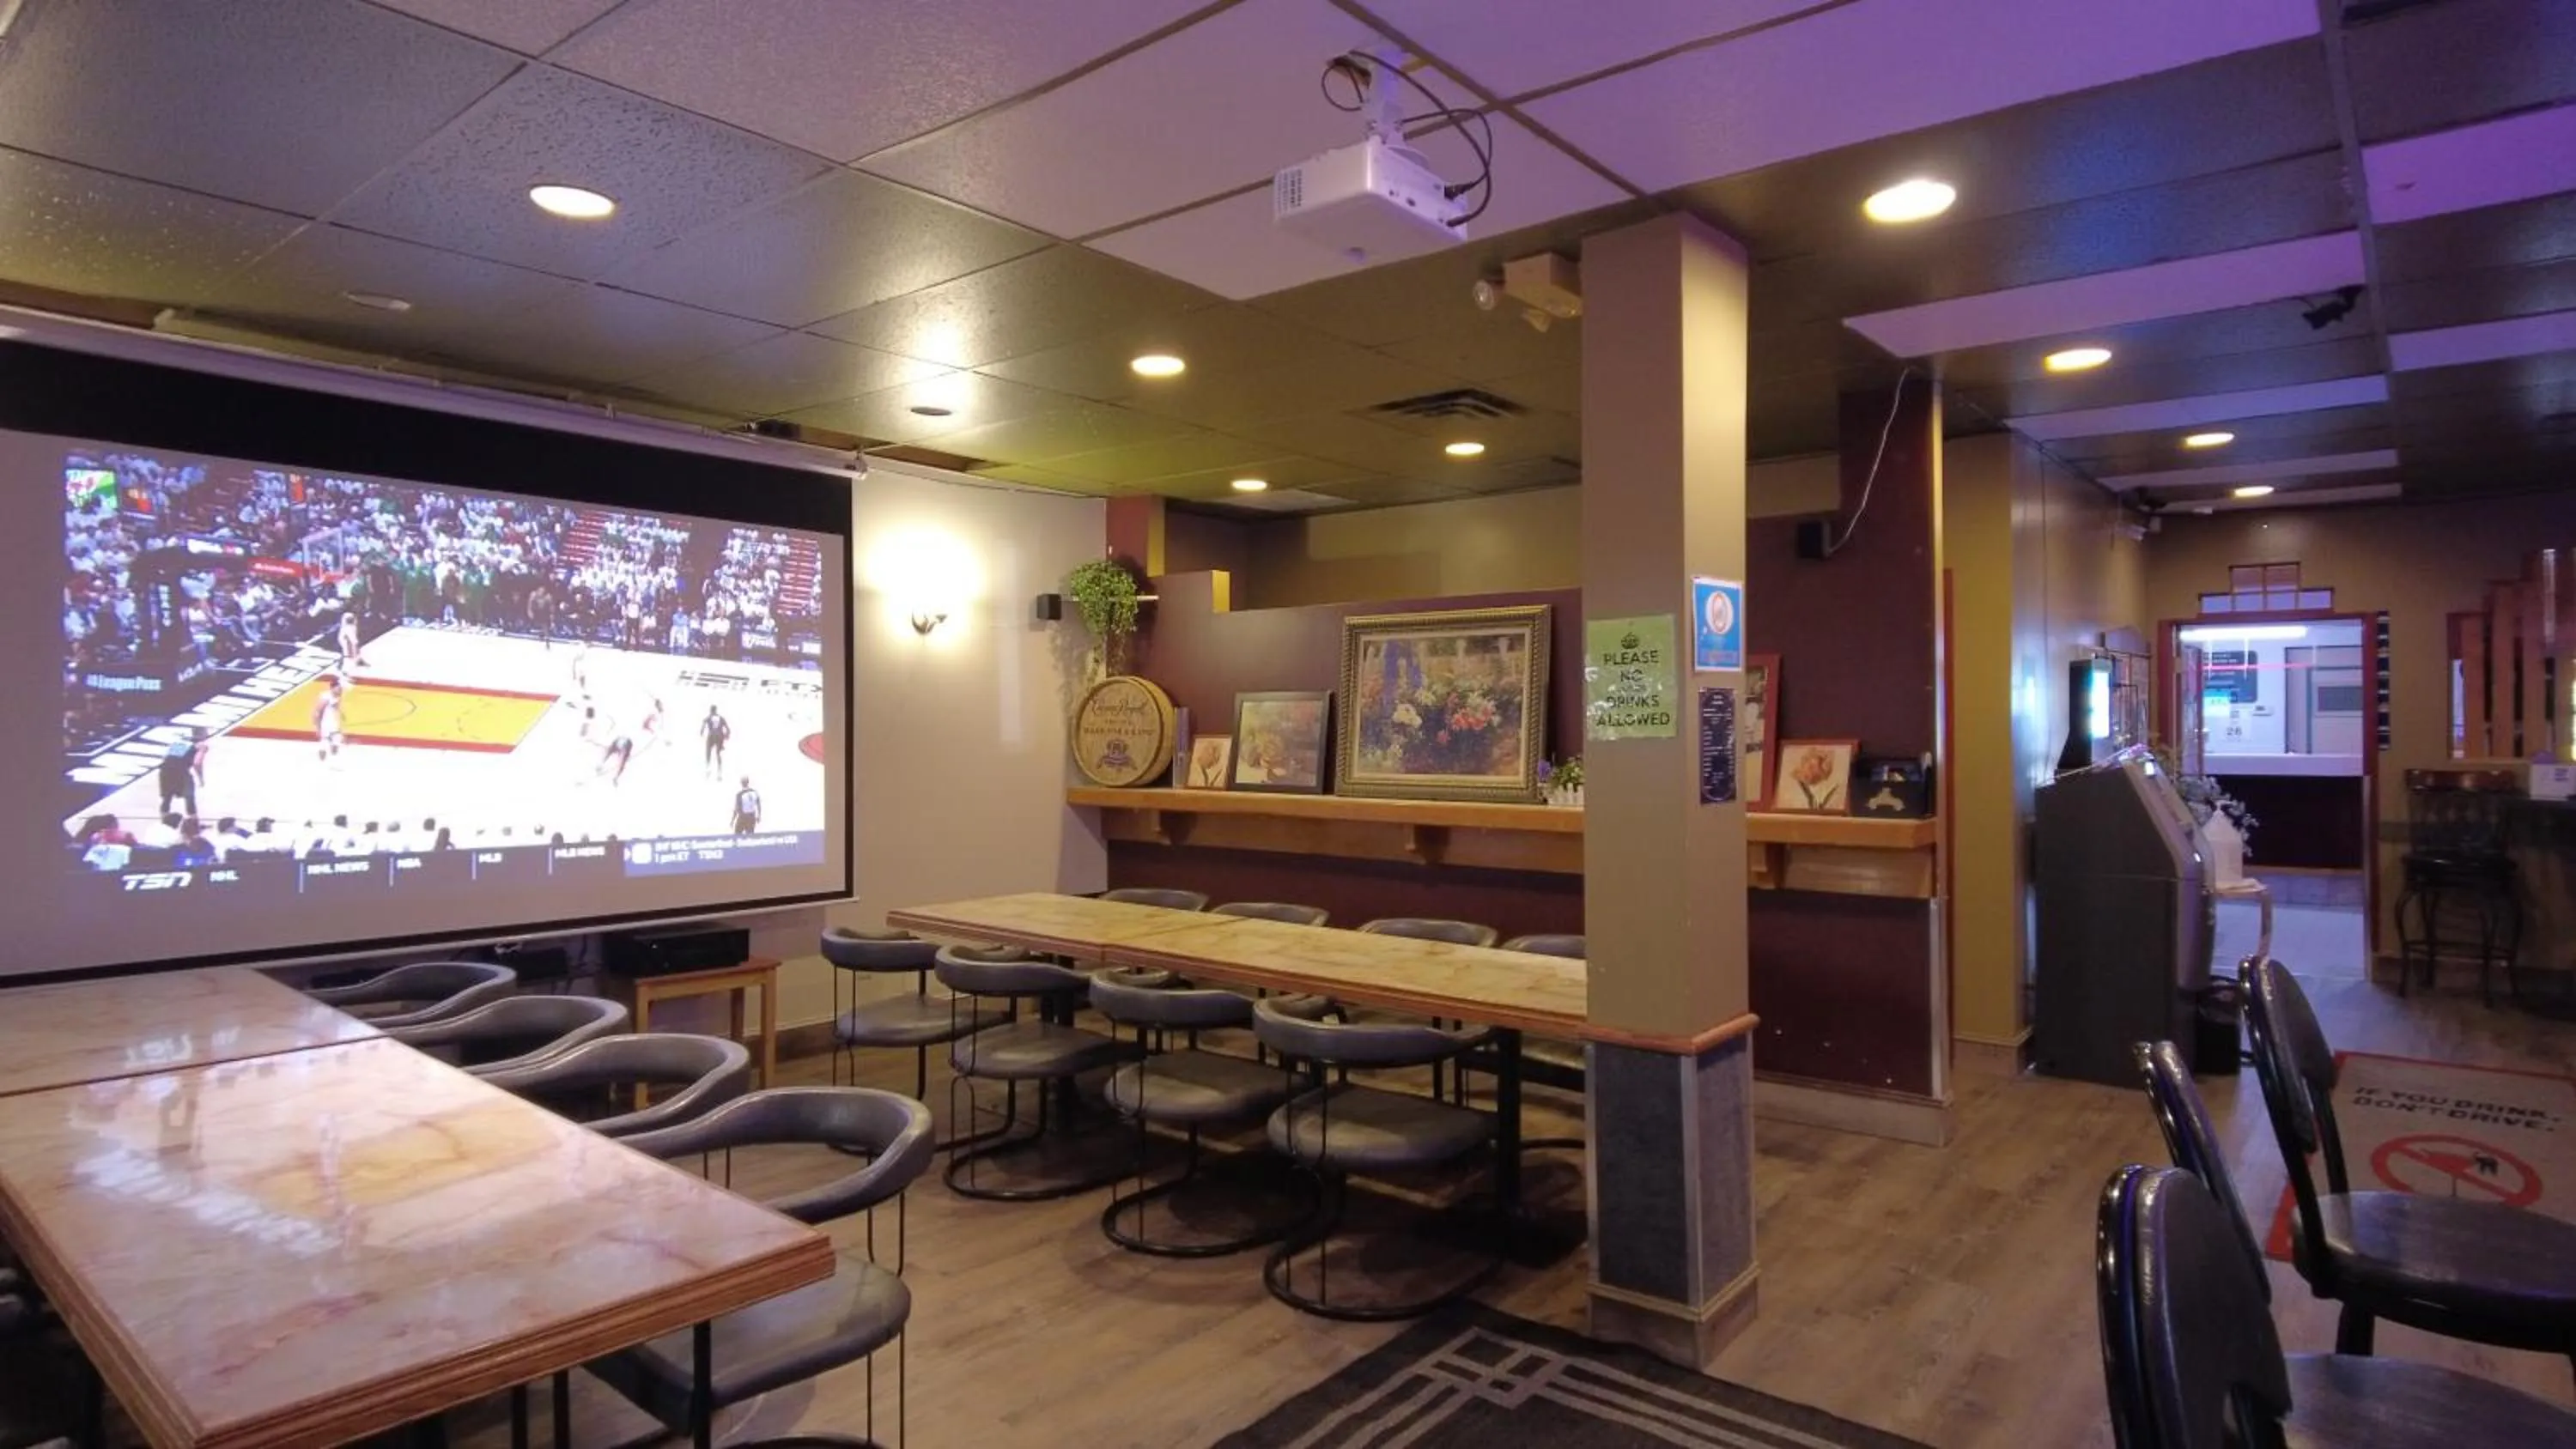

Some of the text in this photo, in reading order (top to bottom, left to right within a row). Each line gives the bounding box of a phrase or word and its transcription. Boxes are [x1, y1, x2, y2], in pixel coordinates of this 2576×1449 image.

[1604, 650, 1659, 664] PLEASE
[1620, 670, 1643, 682] NO
[1607, 694, 1660, 708] DRINKS
[1596, 712, 1670, 727] ALLOWED
[122, 871, 193, 891] TSN
[2391, 1090, 2446, 1105] YOU
[2353, 1096, 2444, 1115] DON'T
